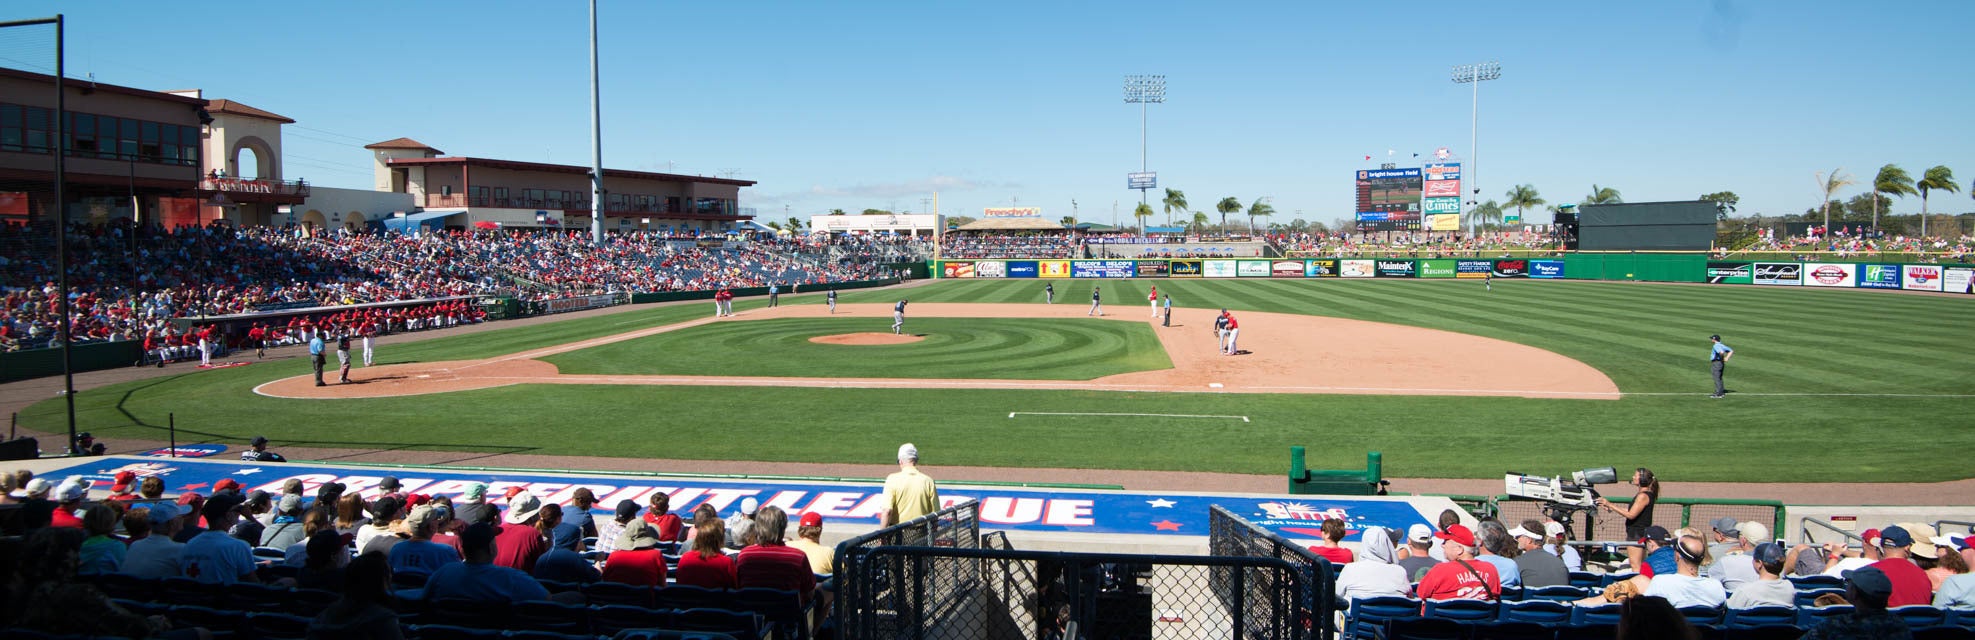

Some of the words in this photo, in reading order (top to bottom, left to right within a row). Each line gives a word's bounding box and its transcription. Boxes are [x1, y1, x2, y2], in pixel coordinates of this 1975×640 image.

[1426, 200, 1459, 211] Times
[985, 208, 1032, 216] Frenchy's
[551, 298, 589, 309] HOOTERS
[757, 489, 1096, 527] LEAUE
